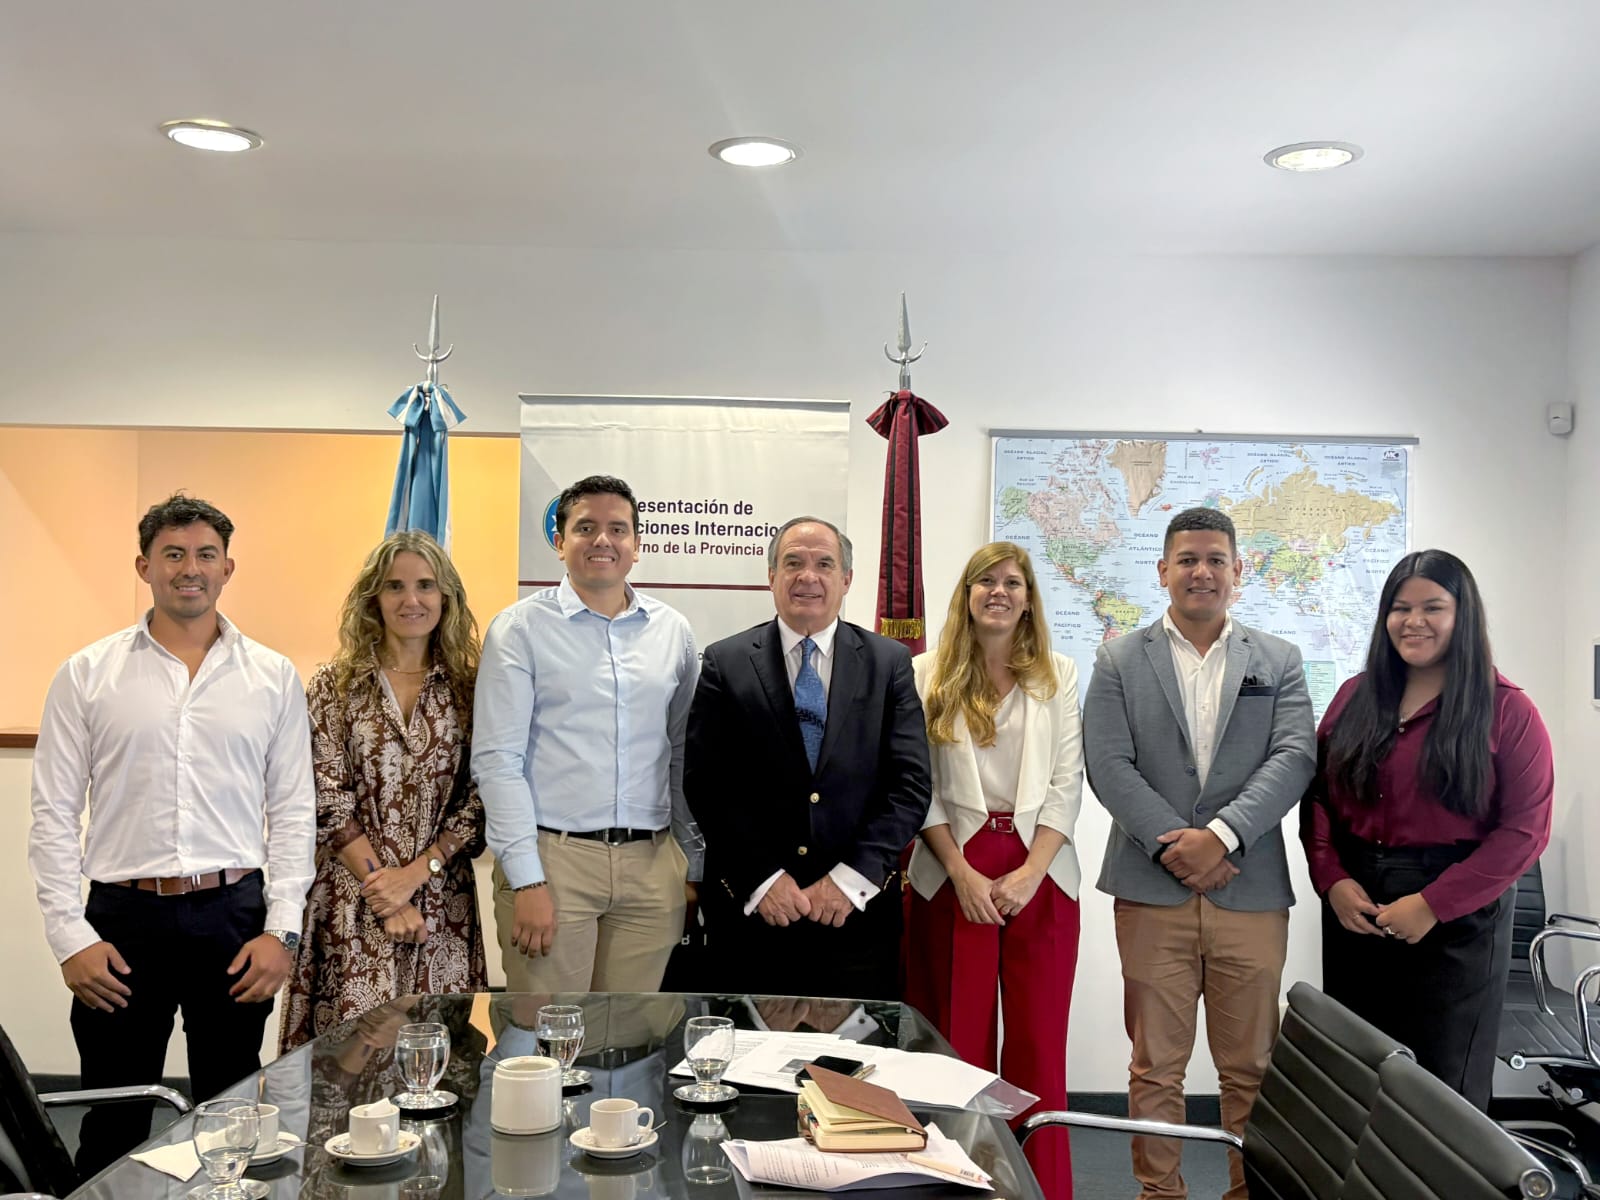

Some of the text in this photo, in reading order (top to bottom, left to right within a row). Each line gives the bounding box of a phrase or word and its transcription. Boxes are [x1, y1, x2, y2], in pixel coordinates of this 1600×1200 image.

[637, 499, 753, 515] esentación de
[637, 519, 778, 538] ciones Internacio
[663, 541, 680, 554] de
[684, 541, 697, 554] la
[700, 542, 764, 556] Provincia
